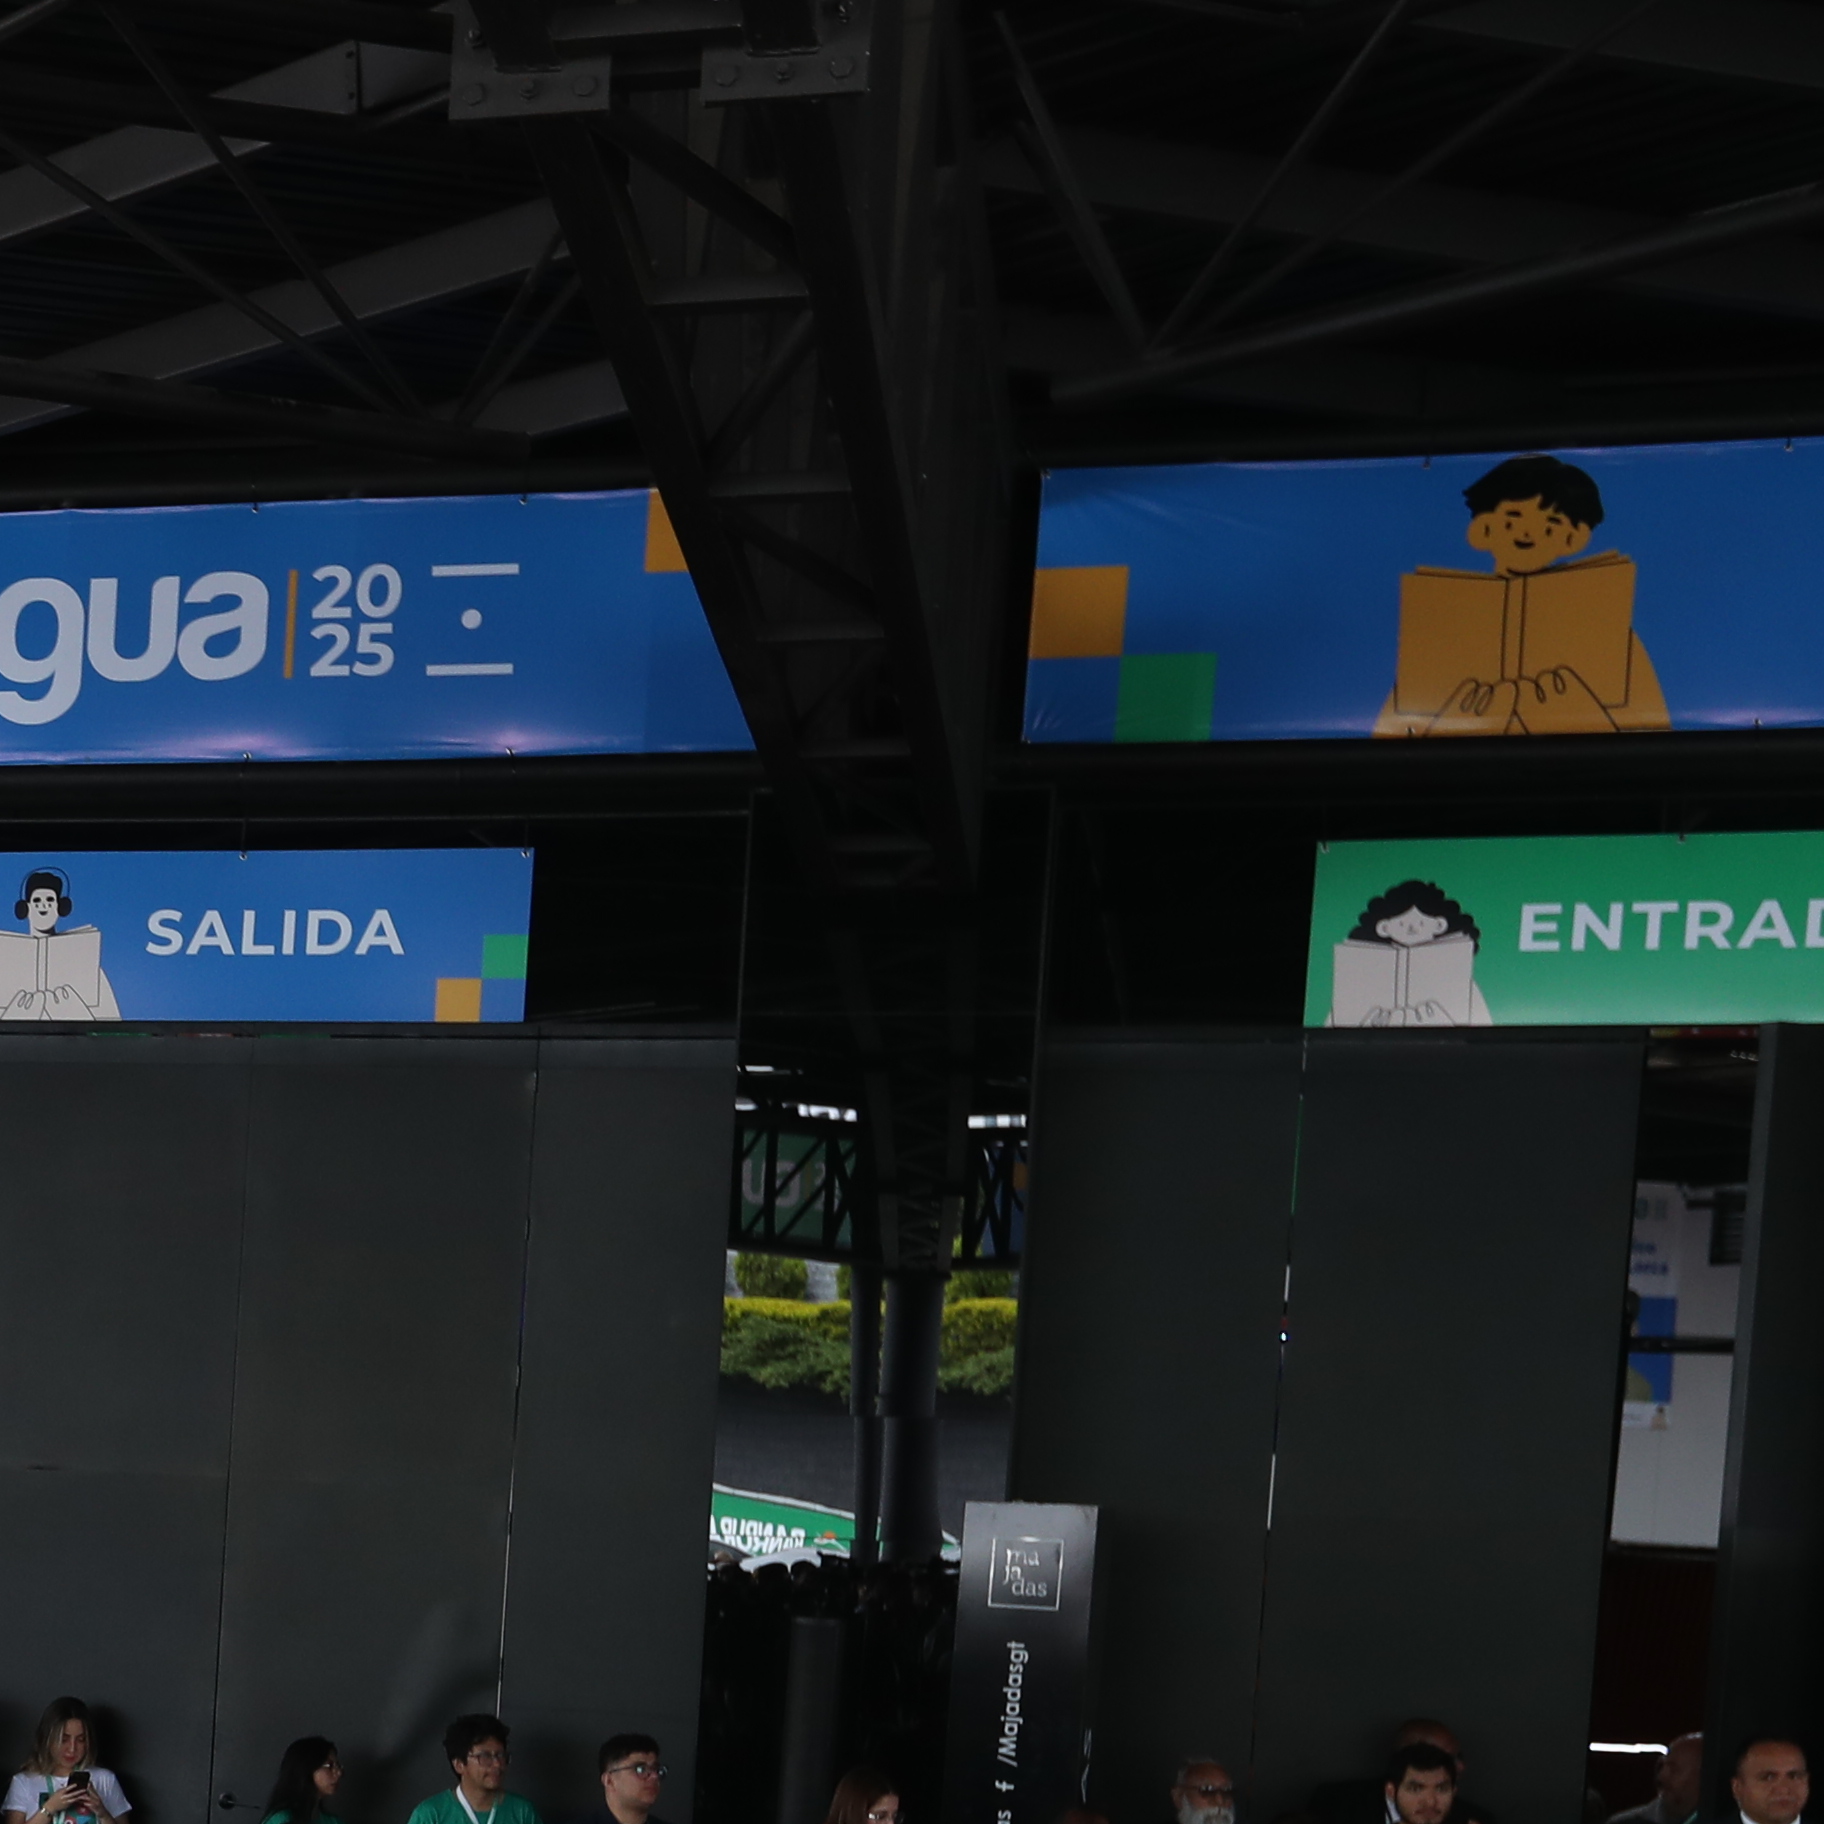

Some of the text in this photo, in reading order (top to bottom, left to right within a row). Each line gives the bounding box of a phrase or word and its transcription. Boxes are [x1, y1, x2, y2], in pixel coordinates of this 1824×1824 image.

[310, 562, 403, 619] 20
[309, 621, 395, 678] 25
[145, 908, 406, 956] SALIDA
[1011, 1576, 1048, 1599] das
[996, 1640, 1030, 1768] /Majadasgt
